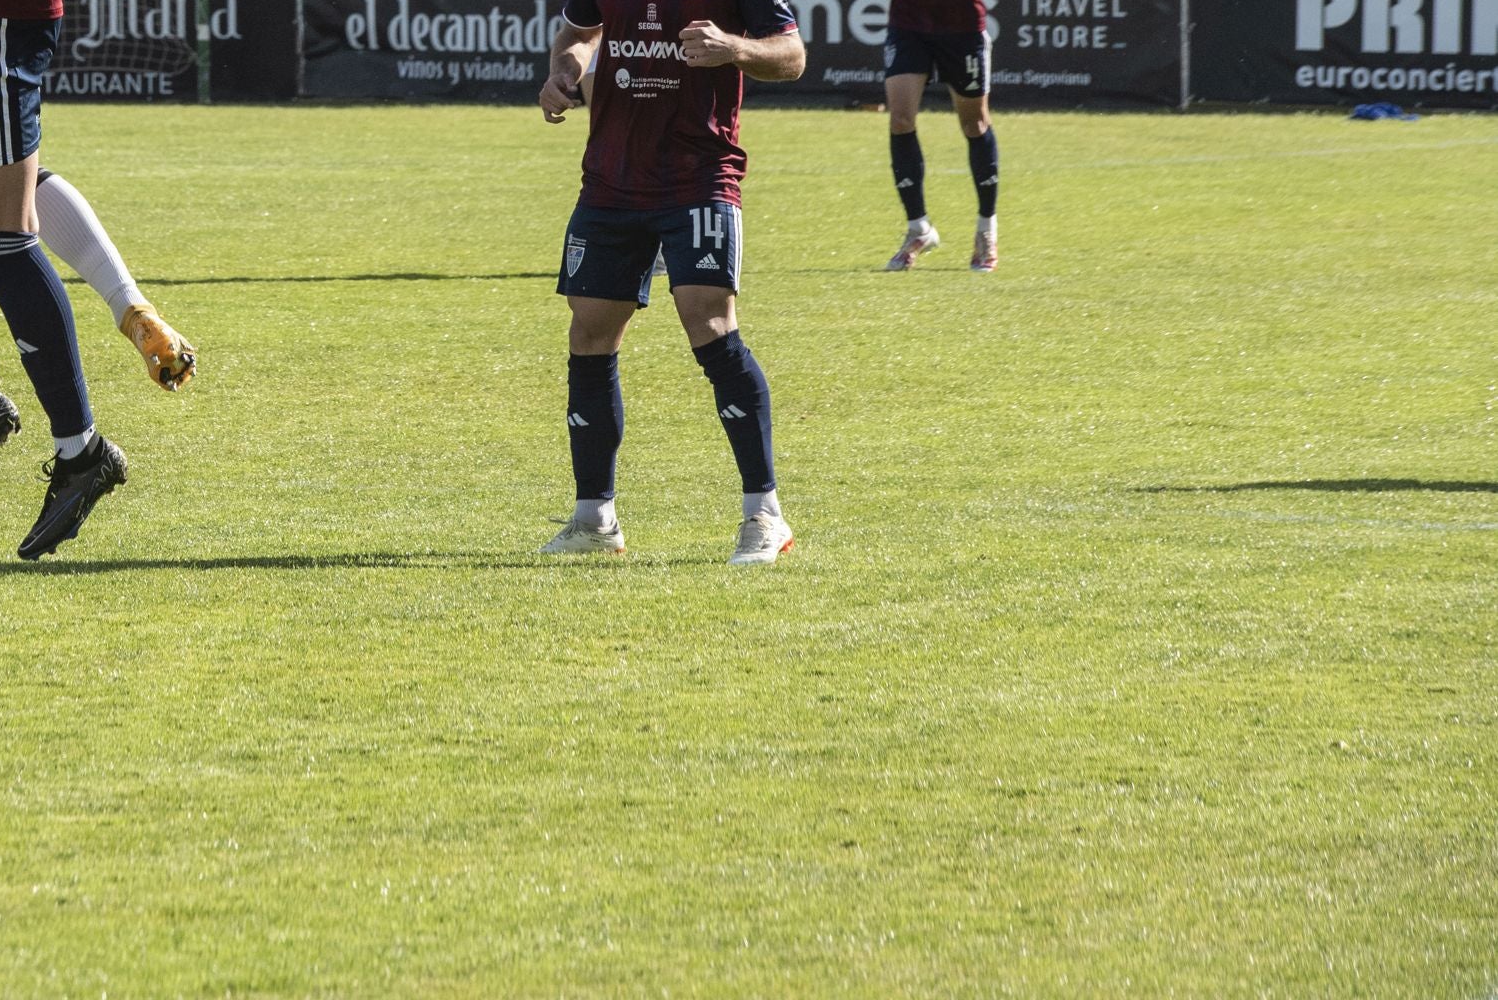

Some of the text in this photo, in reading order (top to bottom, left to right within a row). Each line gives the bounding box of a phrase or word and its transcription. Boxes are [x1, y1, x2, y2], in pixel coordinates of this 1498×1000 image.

[397, 54, 534, 86] vinos y viandas
[964, 53, 980, 79] 4
[689, 206, 725, 249] 14
[695, 261, 721, 271] adidas
